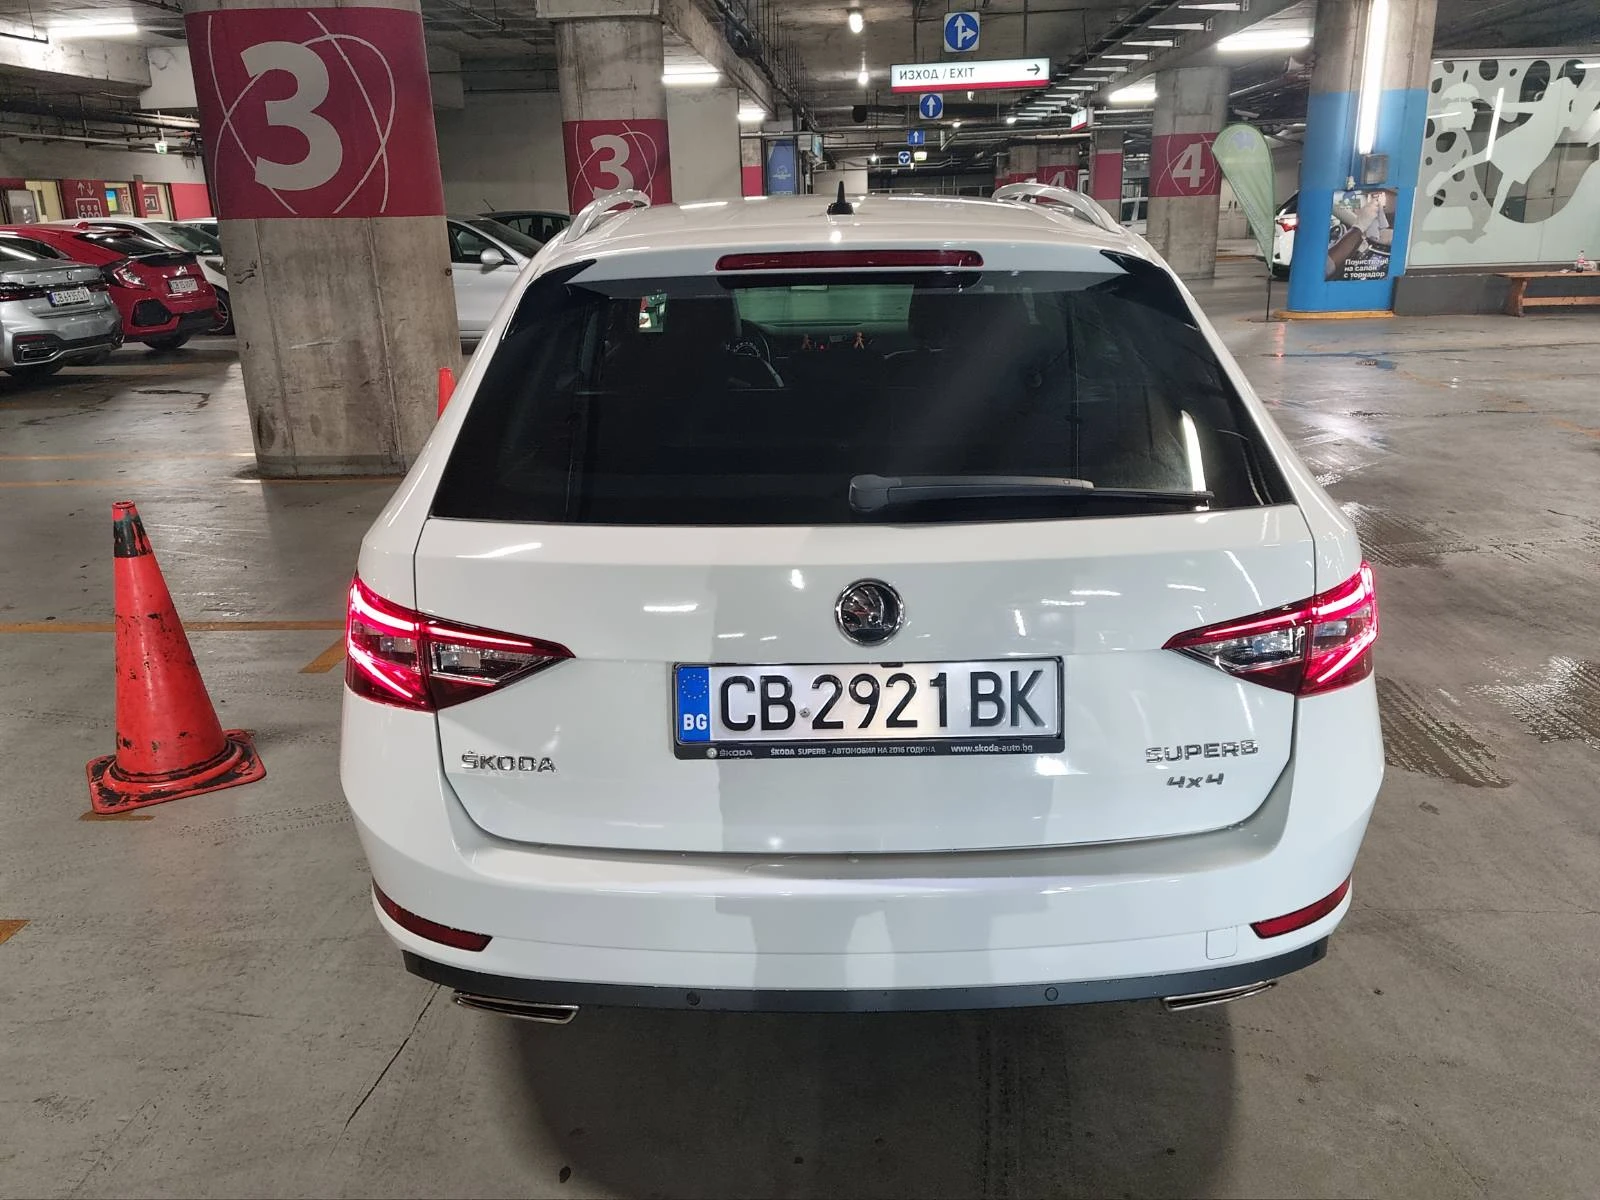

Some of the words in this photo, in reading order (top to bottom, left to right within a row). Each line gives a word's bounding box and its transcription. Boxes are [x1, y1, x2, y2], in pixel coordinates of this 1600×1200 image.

[899, 68, 939, 81] ИЗХОД
[942, 68, 947, 80] /
[950, 67, 976, 79] EXIT
[240, 41, 343, 191] 3
[590, 134, 635, 200] 3
[1172, 143, 1206, 188] 4
[144, 197, 157, 208] P1
[683, 713, 708, 731] BG
[720, 674, 796, 732] CB
[811, 671, 948, 730] 2921
[969, 669, 1046, 728] BK
[797, 746, 827, 756] SUPERB
[831, 746, 876, 755] АВТОМОБИЛ
[877, 746, 888, 754] НА
[905, 745, 936, 754] ГОДИНА
[950, 743, 1034, 753] www.skoda-auto.bg
[1145, 739, 1259, 764] SUPERB
[461, 750, 558, 773] ŠKODA
[1166, 772, 1225, 789] 4x4
